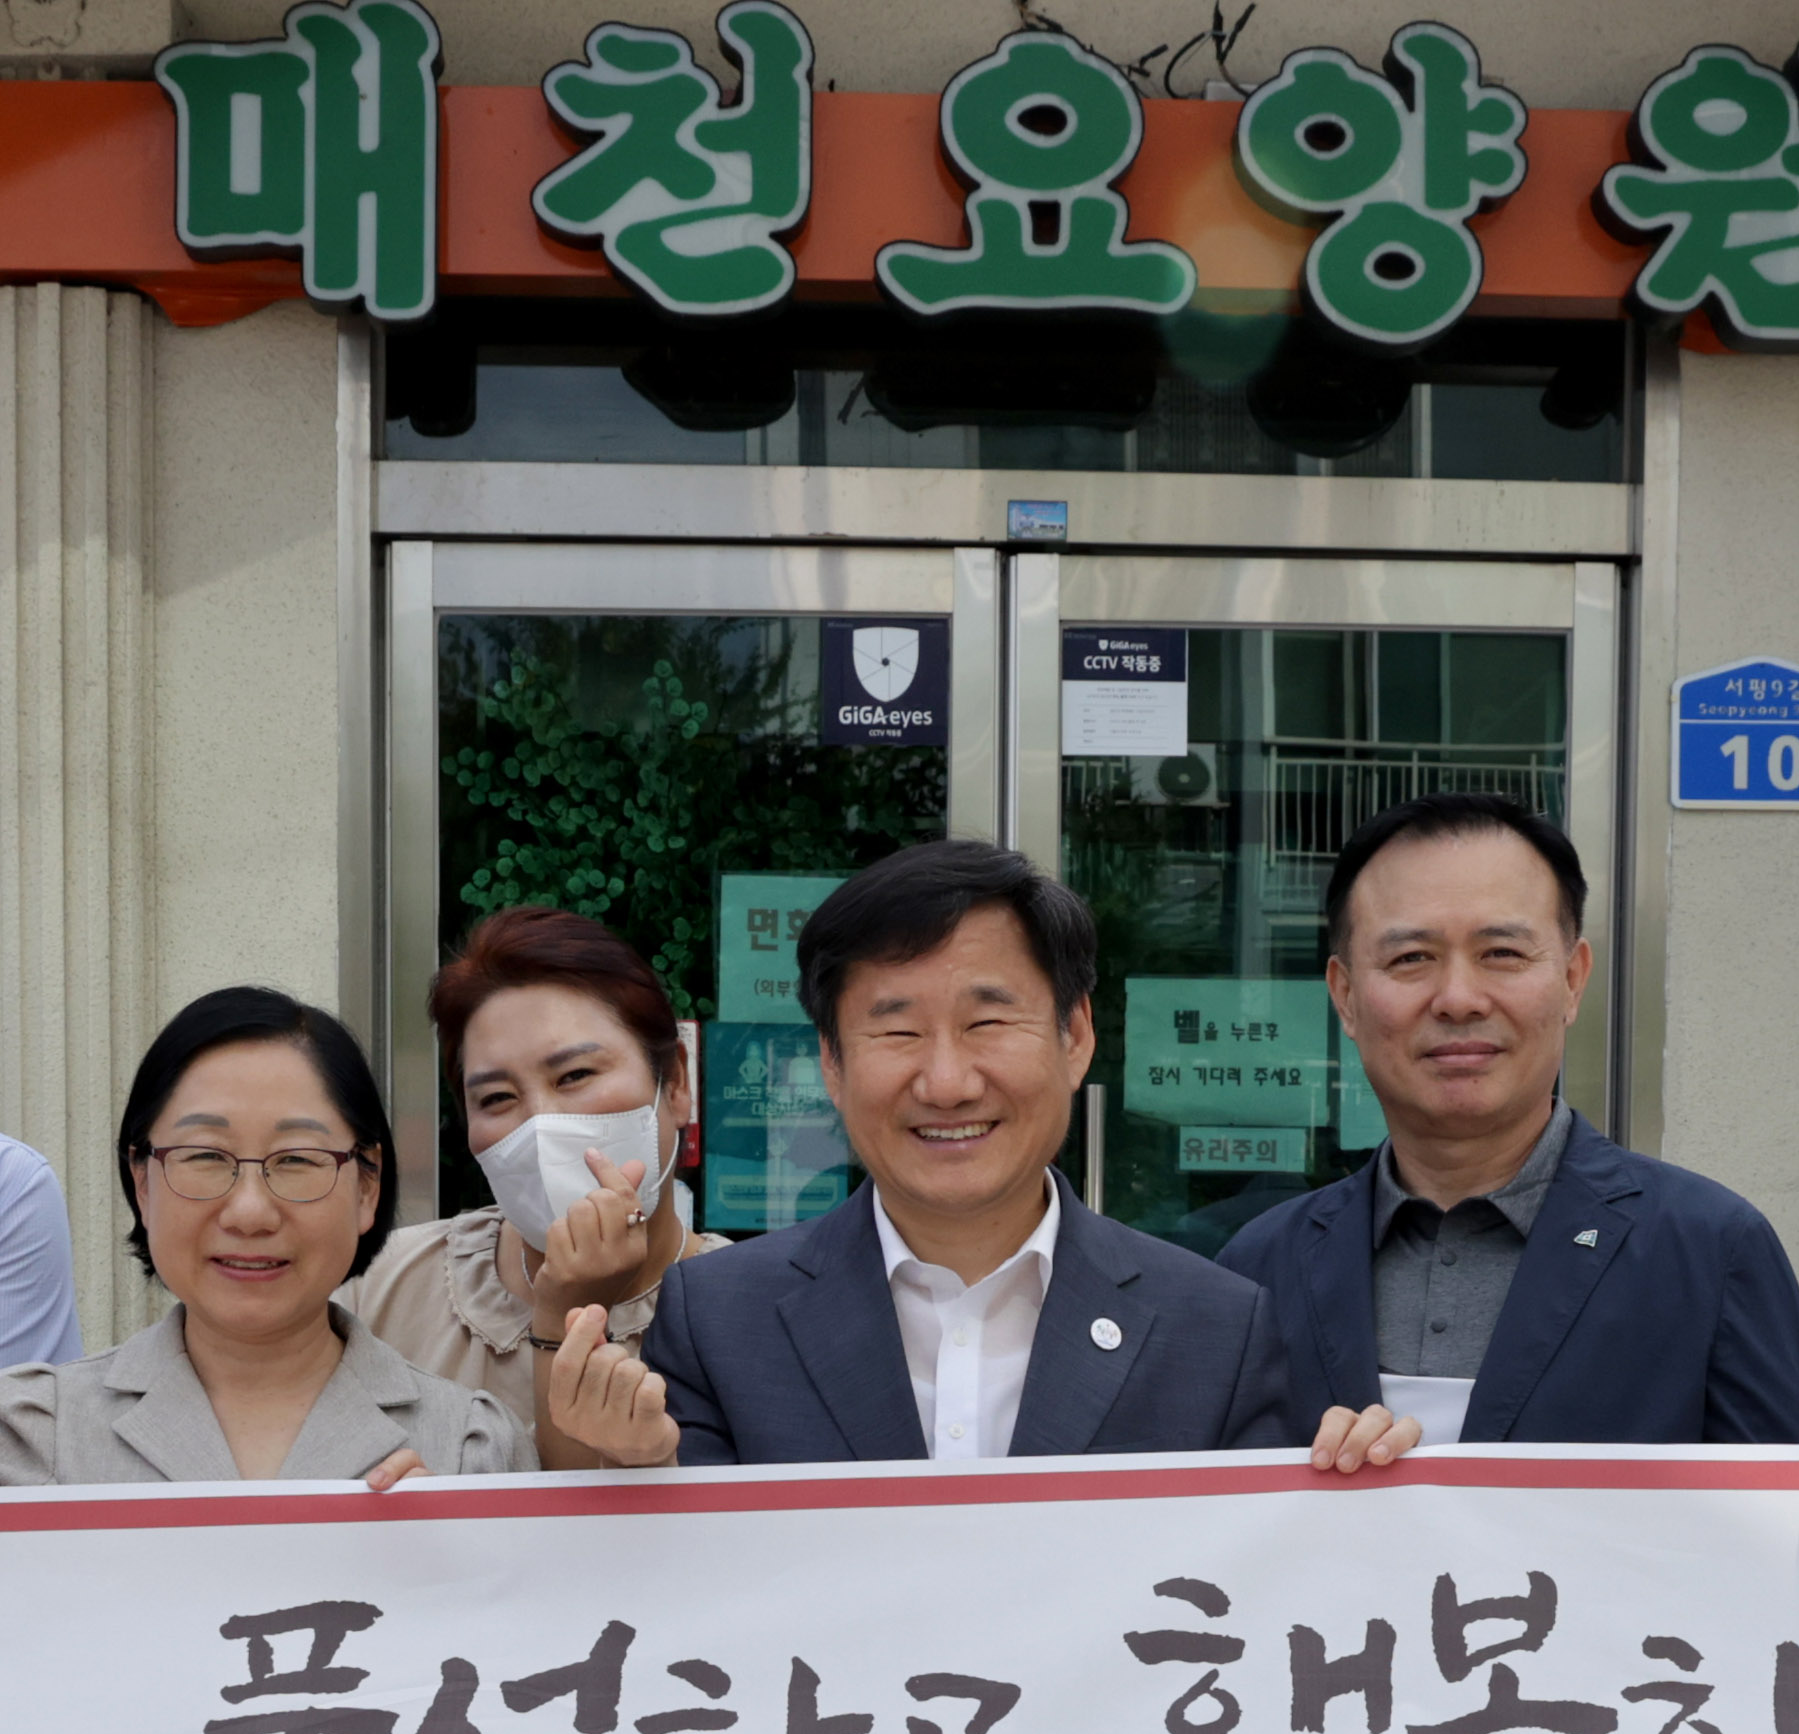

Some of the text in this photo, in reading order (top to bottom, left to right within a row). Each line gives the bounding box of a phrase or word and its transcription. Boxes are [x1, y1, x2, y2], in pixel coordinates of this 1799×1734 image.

[1083, 655, 1162, 673] CCTV 작동중
[1174, 1009, 1218, 1044] 벨을
[1148, 1065, 1302, 1087] 잠시 기다려 주세요
[1182, 1136, 1279, 1164] 유리주의
